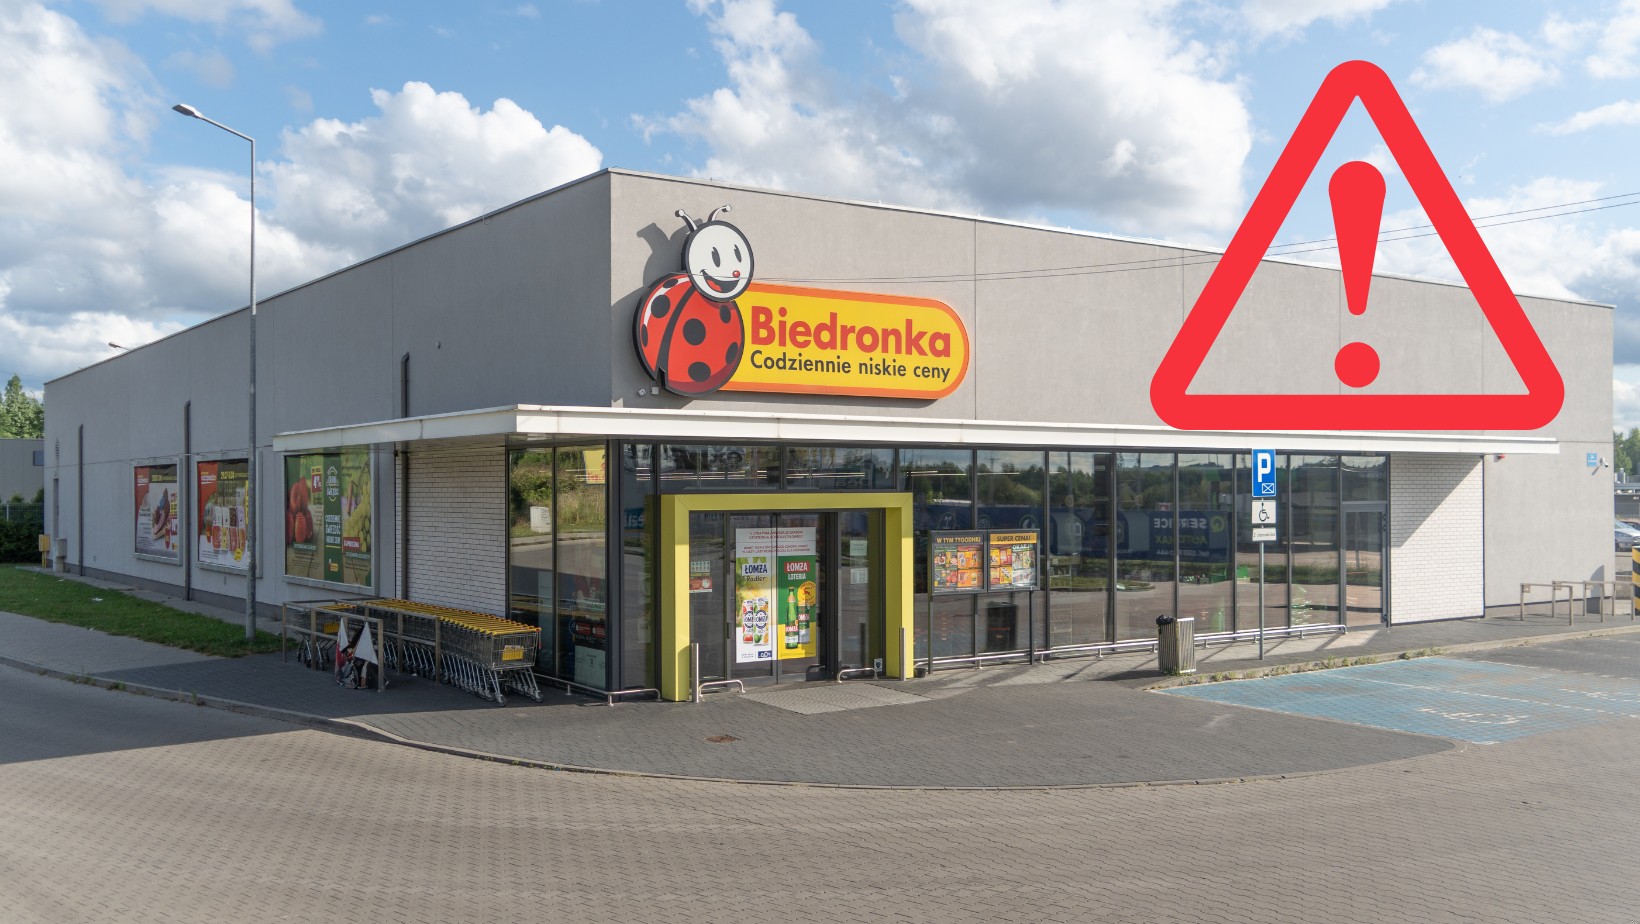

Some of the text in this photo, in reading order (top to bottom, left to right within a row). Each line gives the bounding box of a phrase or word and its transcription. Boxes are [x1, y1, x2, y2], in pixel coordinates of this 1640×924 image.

[751, 304, 951, 358] Biedronka
[750, 349, 951, 382] Codziennie niskie ceny
[1257, 452, 1272, 483] P
[744, 564, 768, 575] ŁOMŻA
[786, 562, 808, 572] ŁOMŻA
